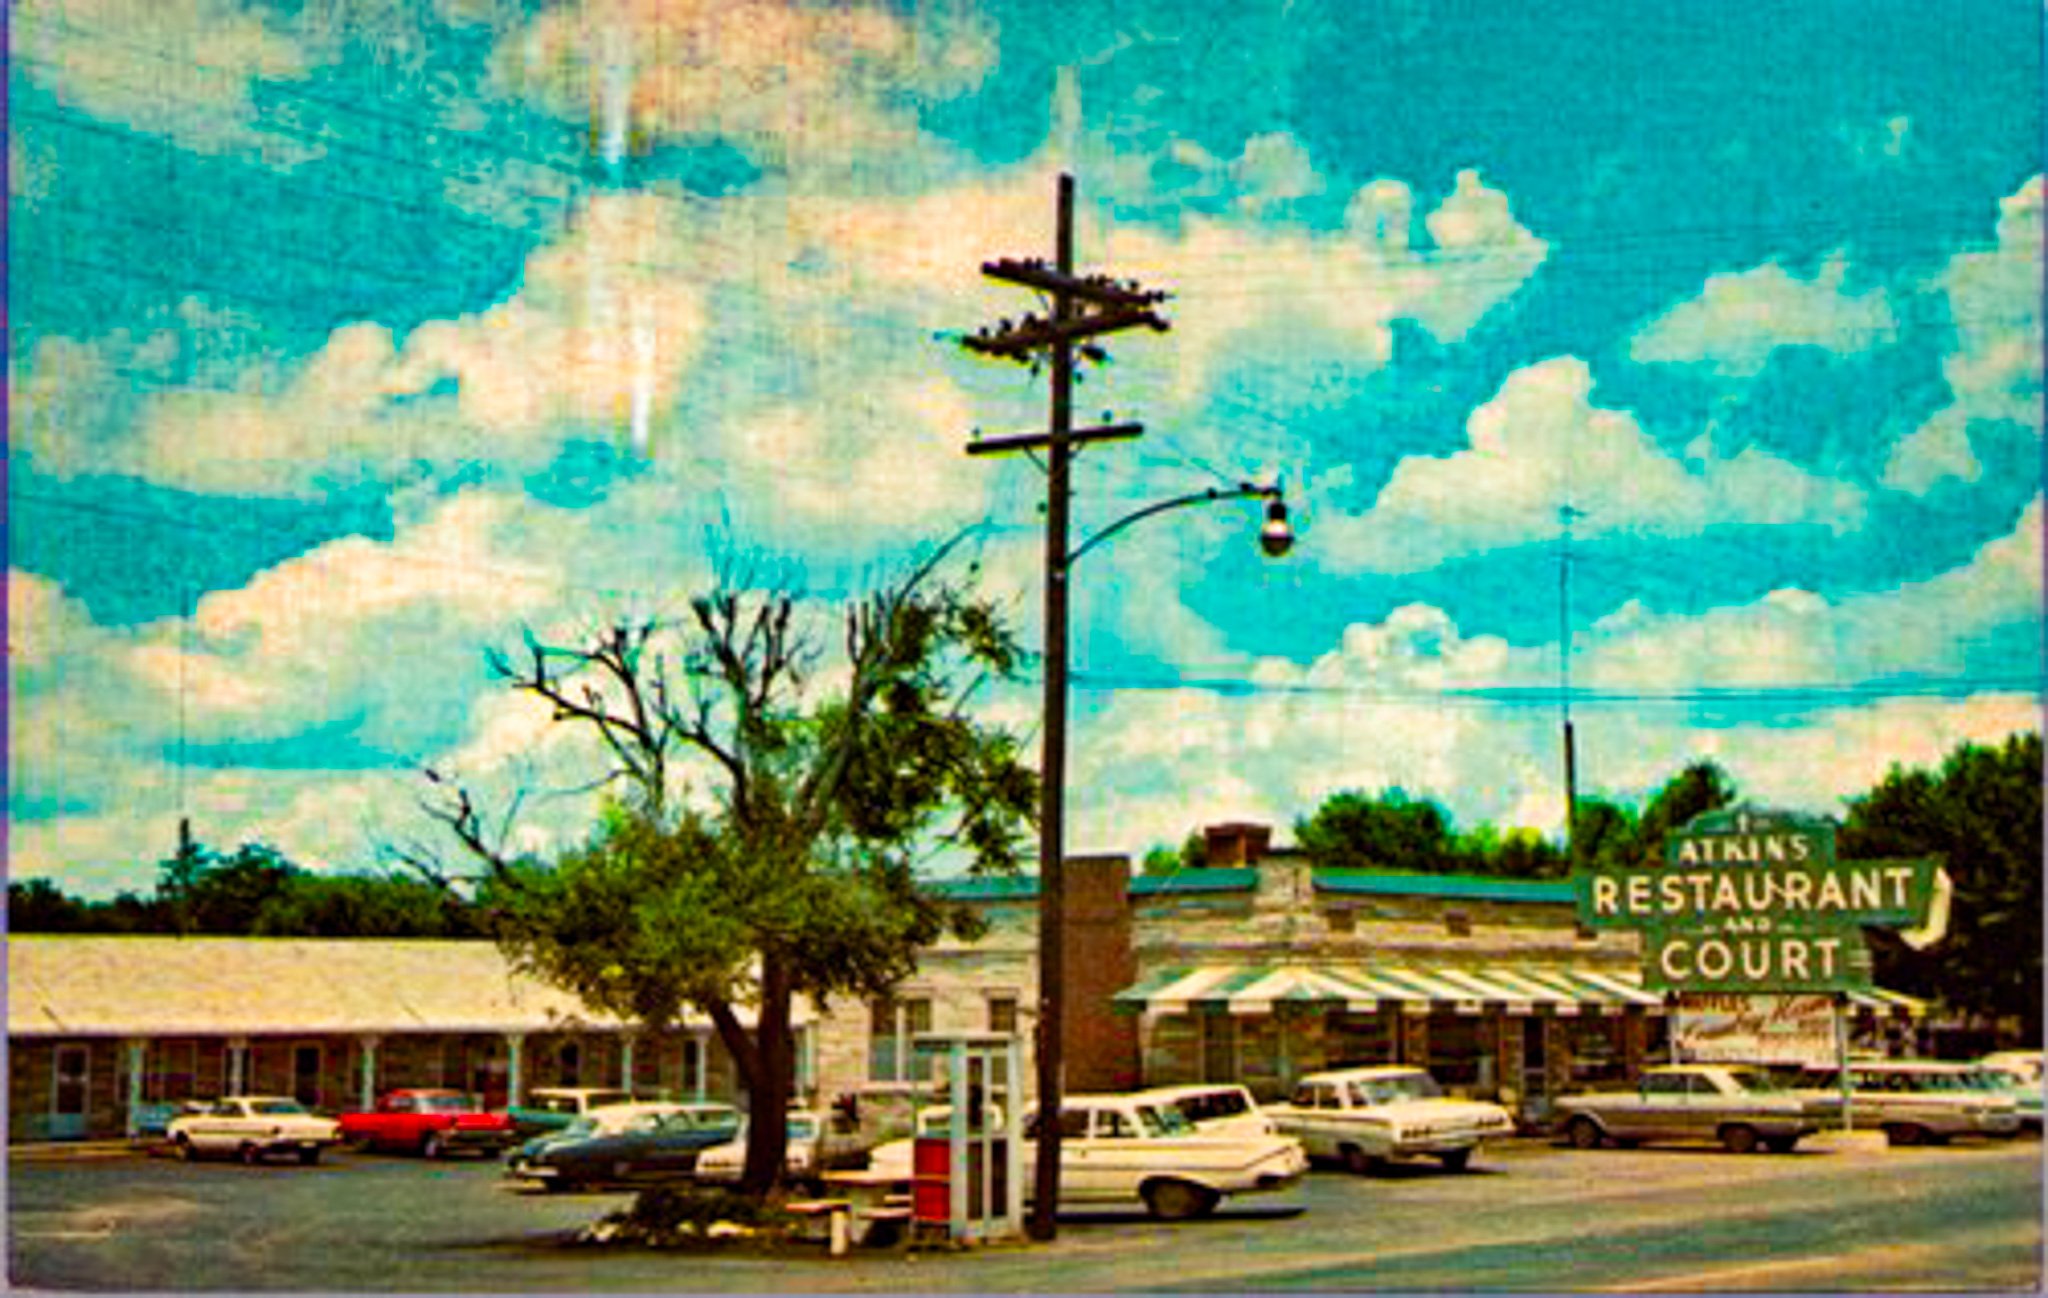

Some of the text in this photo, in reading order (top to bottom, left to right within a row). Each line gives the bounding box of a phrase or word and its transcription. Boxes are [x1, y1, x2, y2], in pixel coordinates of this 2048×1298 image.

[1679, 835, 1809, 863] ATKINS
[1592, 867, 1914, 914] RESTAURANT
[1723, 917, 1771, 932] AND
[1660, 940, 1840, 979] COURT
